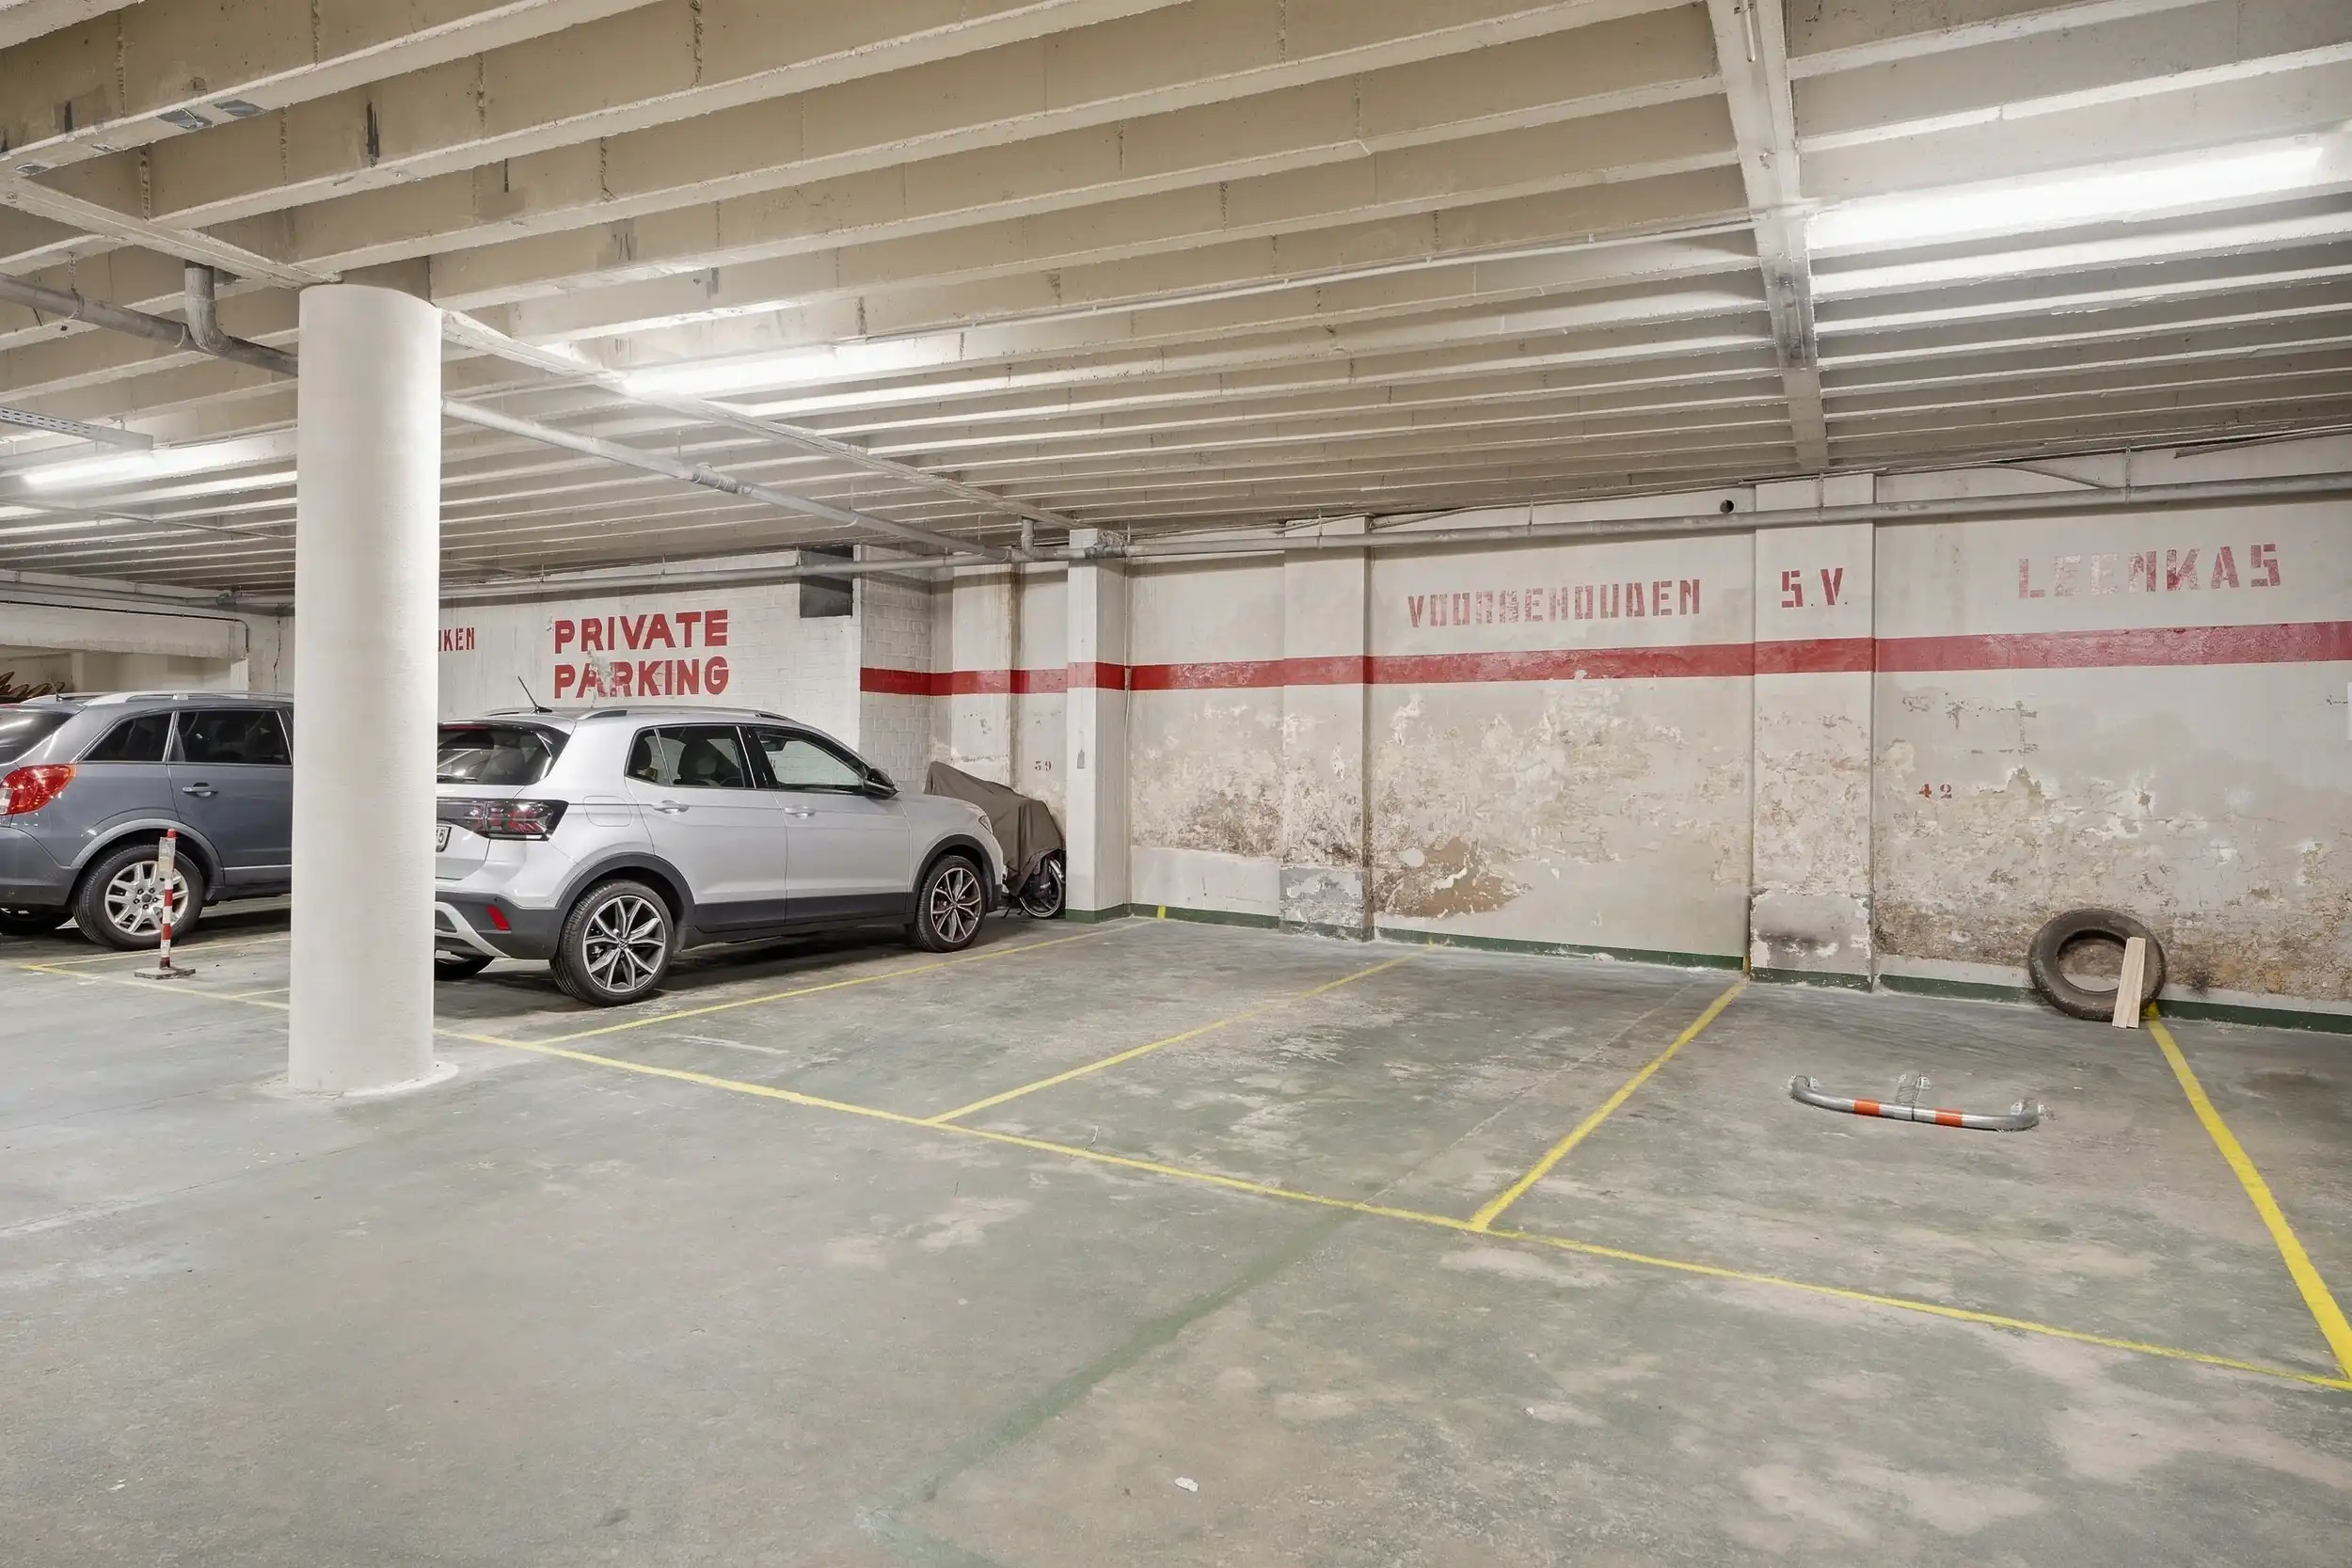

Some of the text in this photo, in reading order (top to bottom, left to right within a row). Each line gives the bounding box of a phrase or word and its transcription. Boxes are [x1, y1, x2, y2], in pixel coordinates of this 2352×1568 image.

[1407, 578, 1700, 627] VOORBEHOUDEN
[2018, 544, 2280, 599] LEENKAS
[438, 626, 475, 652] KEN
[554, 610, 728, 654] PRIVATE
[554, 656, 729, 699] PARKING
[1035, 760, 1052, 771] 59
[1916, 783, 1952, 800] 42
